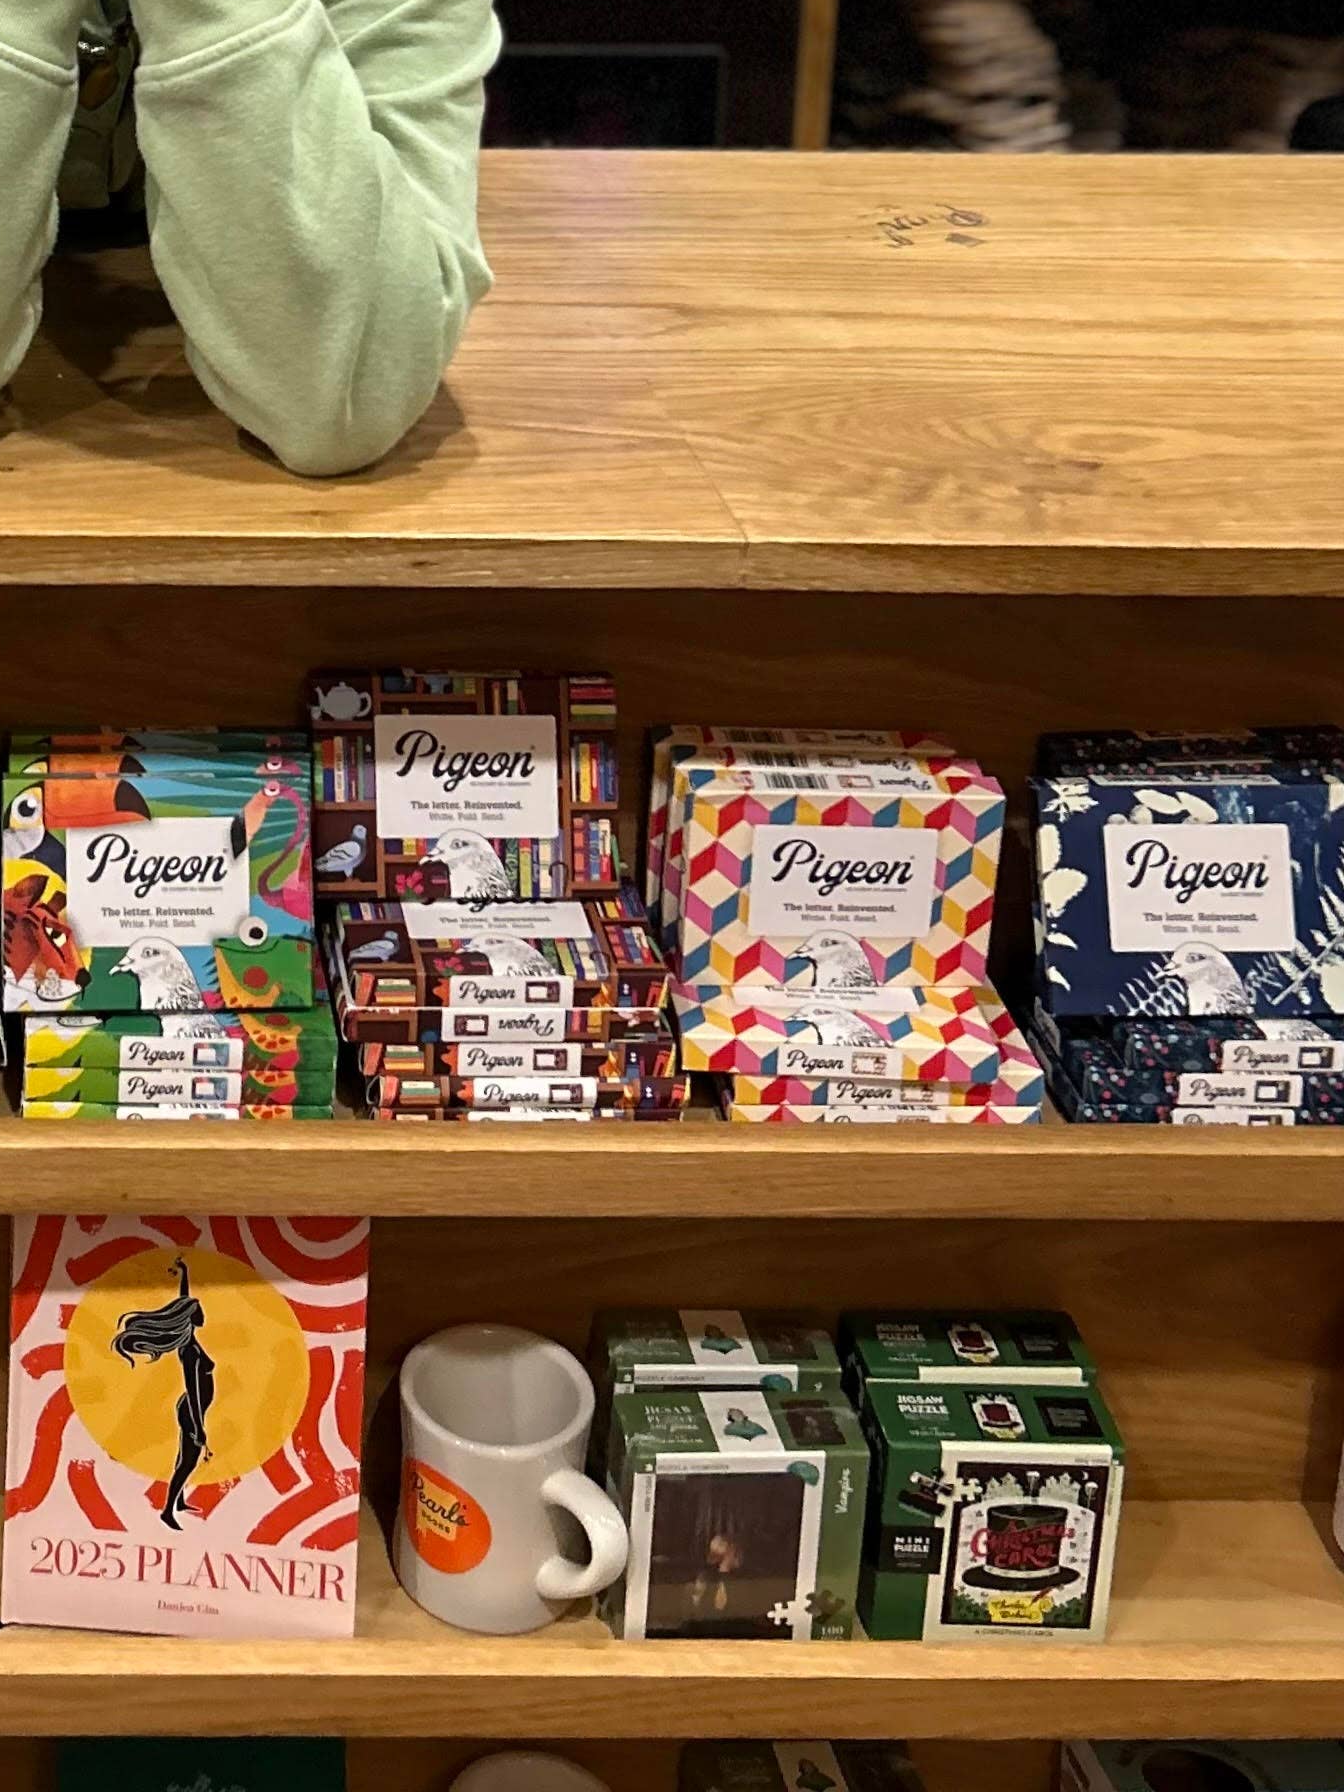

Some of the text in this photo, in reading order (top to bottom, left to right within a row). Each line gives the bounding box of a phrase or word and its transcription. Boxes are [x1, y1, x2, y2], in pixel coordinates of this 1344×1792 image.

[395, 730, 535, 792] Pigeon
[411, 801, 429, 810] The
[86, 833, 228, 898] Pigeon
[771, 839, 913, 896] Pigeon
[1126, 840, 1269, 903] Pigeon
[101, 907, 120, 916] The
[459, 981, 516, 1002] Pigeon
[128, 1043, 185, 1064] Pigeon
[468, 1048, 524, 1069] Pigeon
[787, 1051, 844, 1074] Pigeon
[1234, 1045, 1289, 1067] Pigeon
[128, 1078, 184, 1099] Pigeon
[483, 1084, 540, 1105] Pigeon
[836, 1080, 893, 1102] Pigeon
[1191, 1079, 1247, 1101] Pigeon
[30, 1536, 348, 1602] 2025 PLANNER
